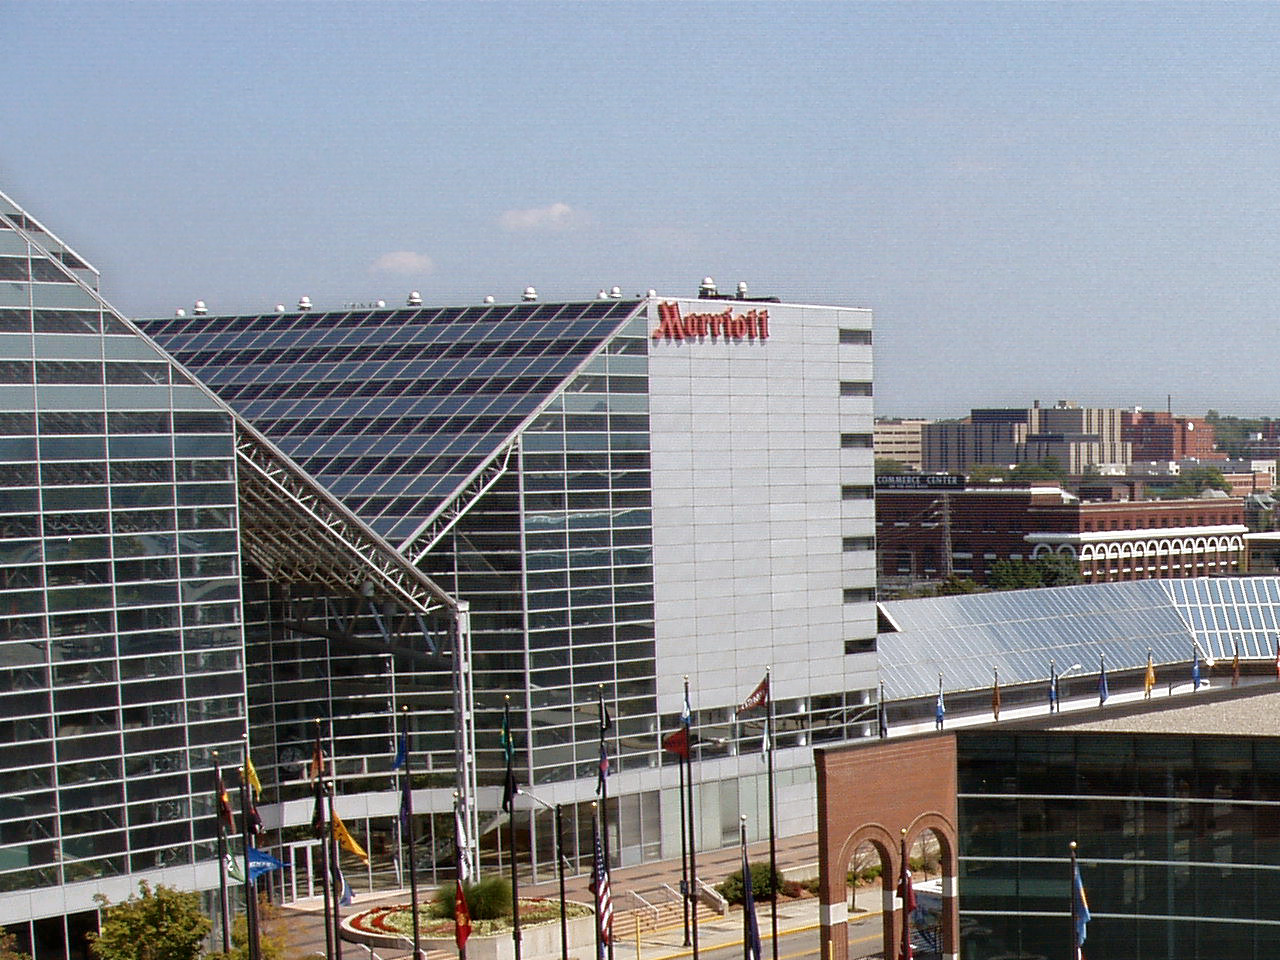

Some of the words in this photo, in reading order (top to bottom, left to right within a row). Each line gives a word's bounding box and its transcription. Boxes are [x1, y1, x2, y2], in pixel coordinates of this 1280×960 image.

[652, 301, 770, 340] Marriott
[876, 475, 921, 485] COMMERCE
[927, 476, 958, 485] CENTER
